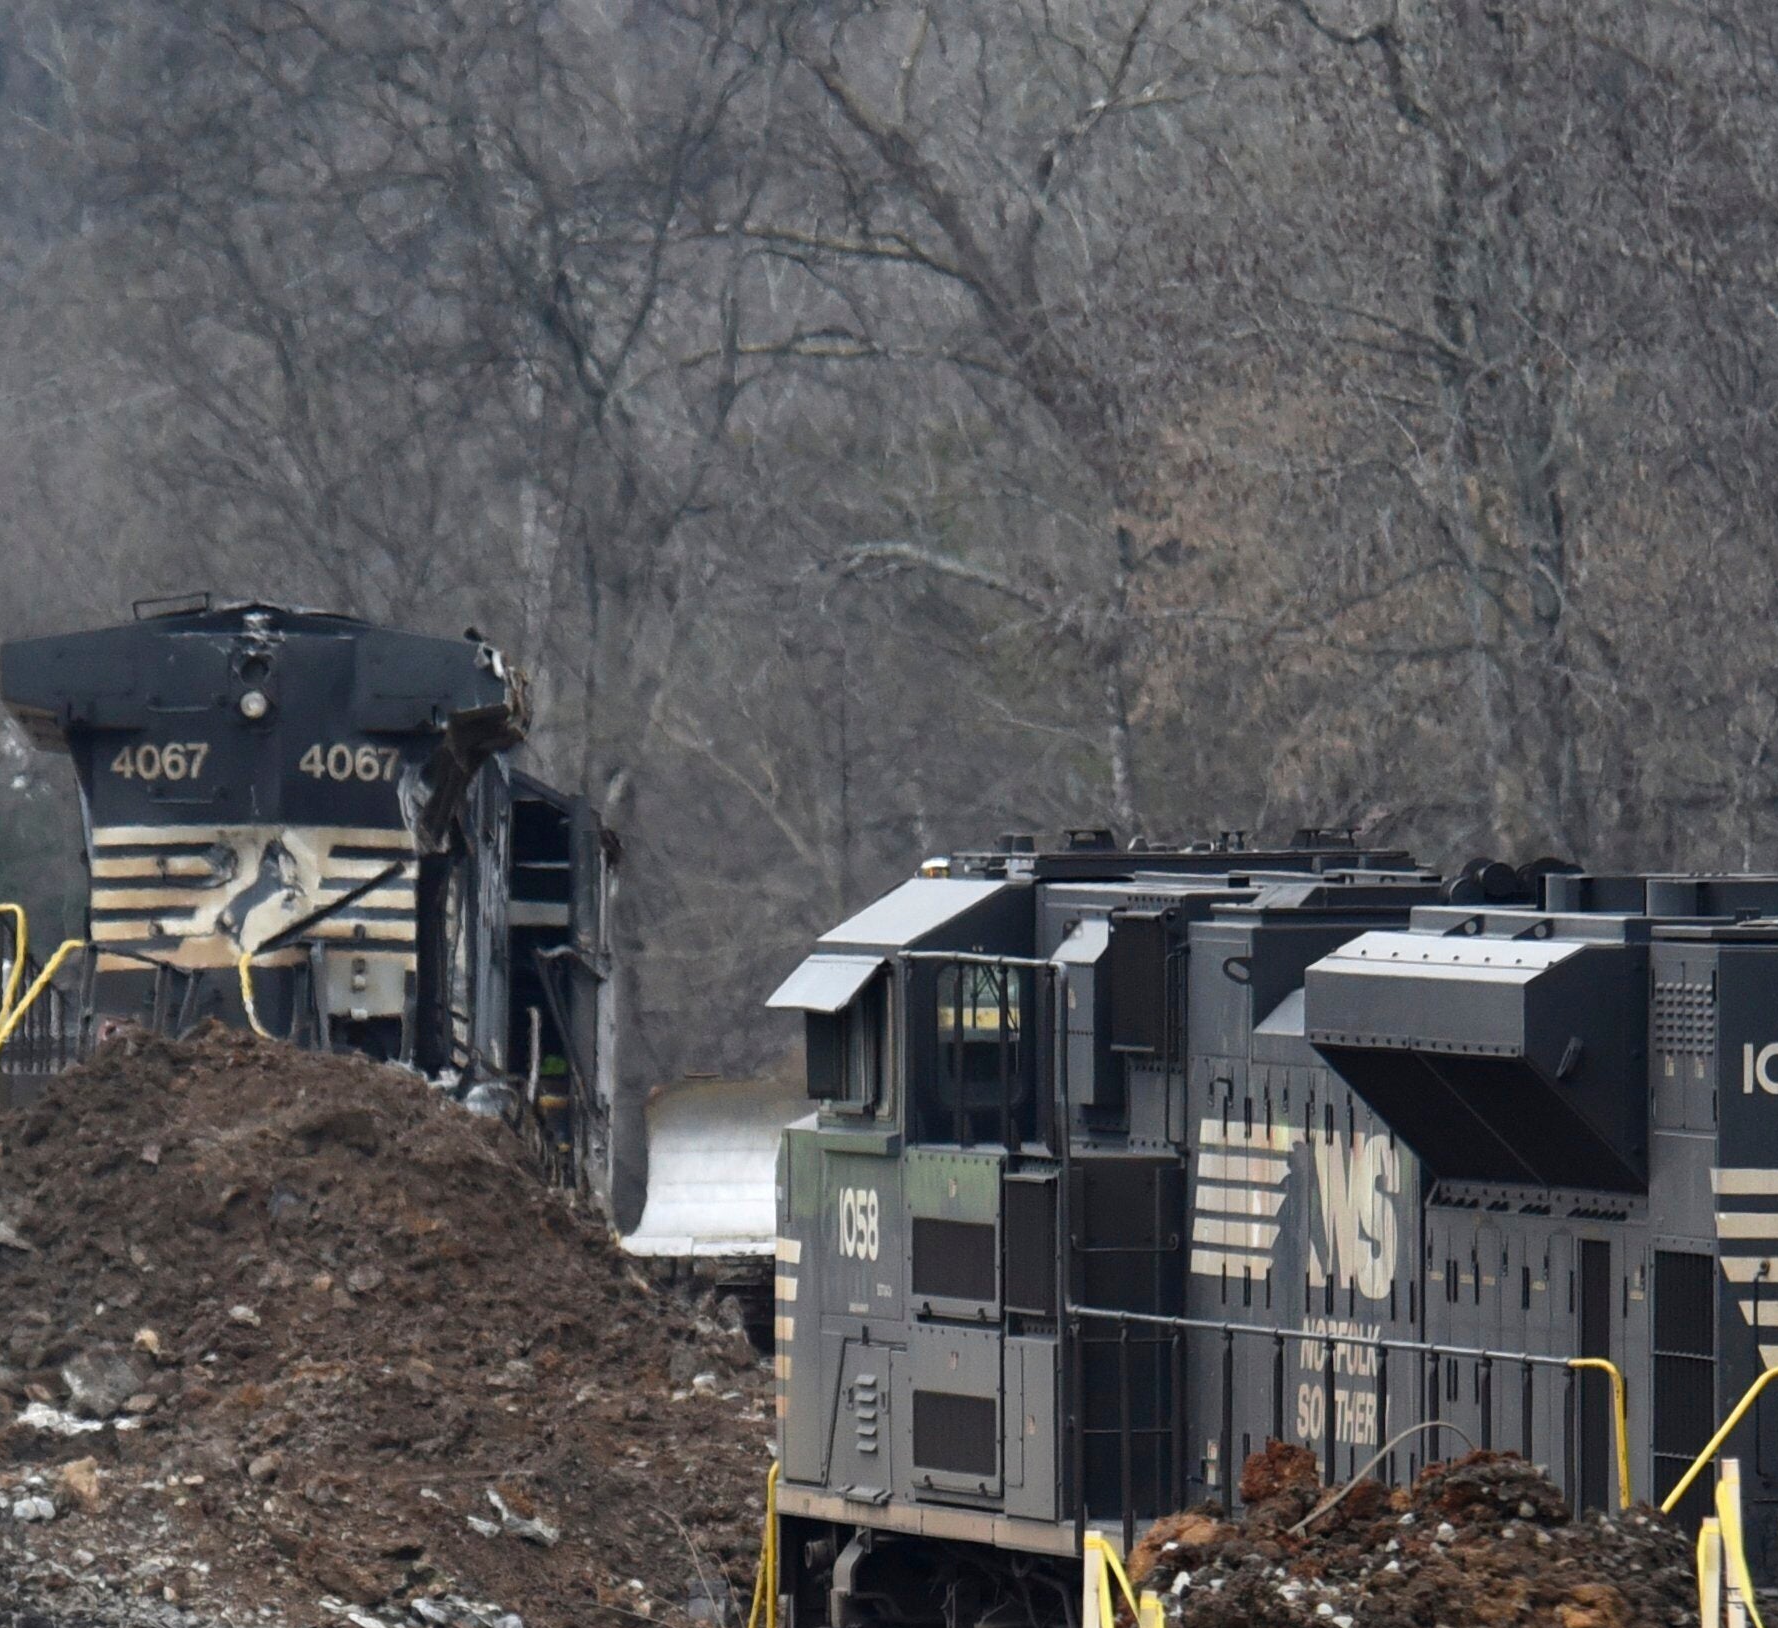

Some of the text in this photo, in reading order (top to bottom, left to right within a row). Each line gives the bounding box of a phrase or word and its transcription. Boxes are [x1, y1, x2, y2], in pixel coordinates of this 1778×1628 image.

[110, 742, 208, 781] 4067
[299, 743, 399, 782] 4067
[839, 1187, 880, 1262] 1058
[1297, 1383, 1390, 1446] SOTHER
